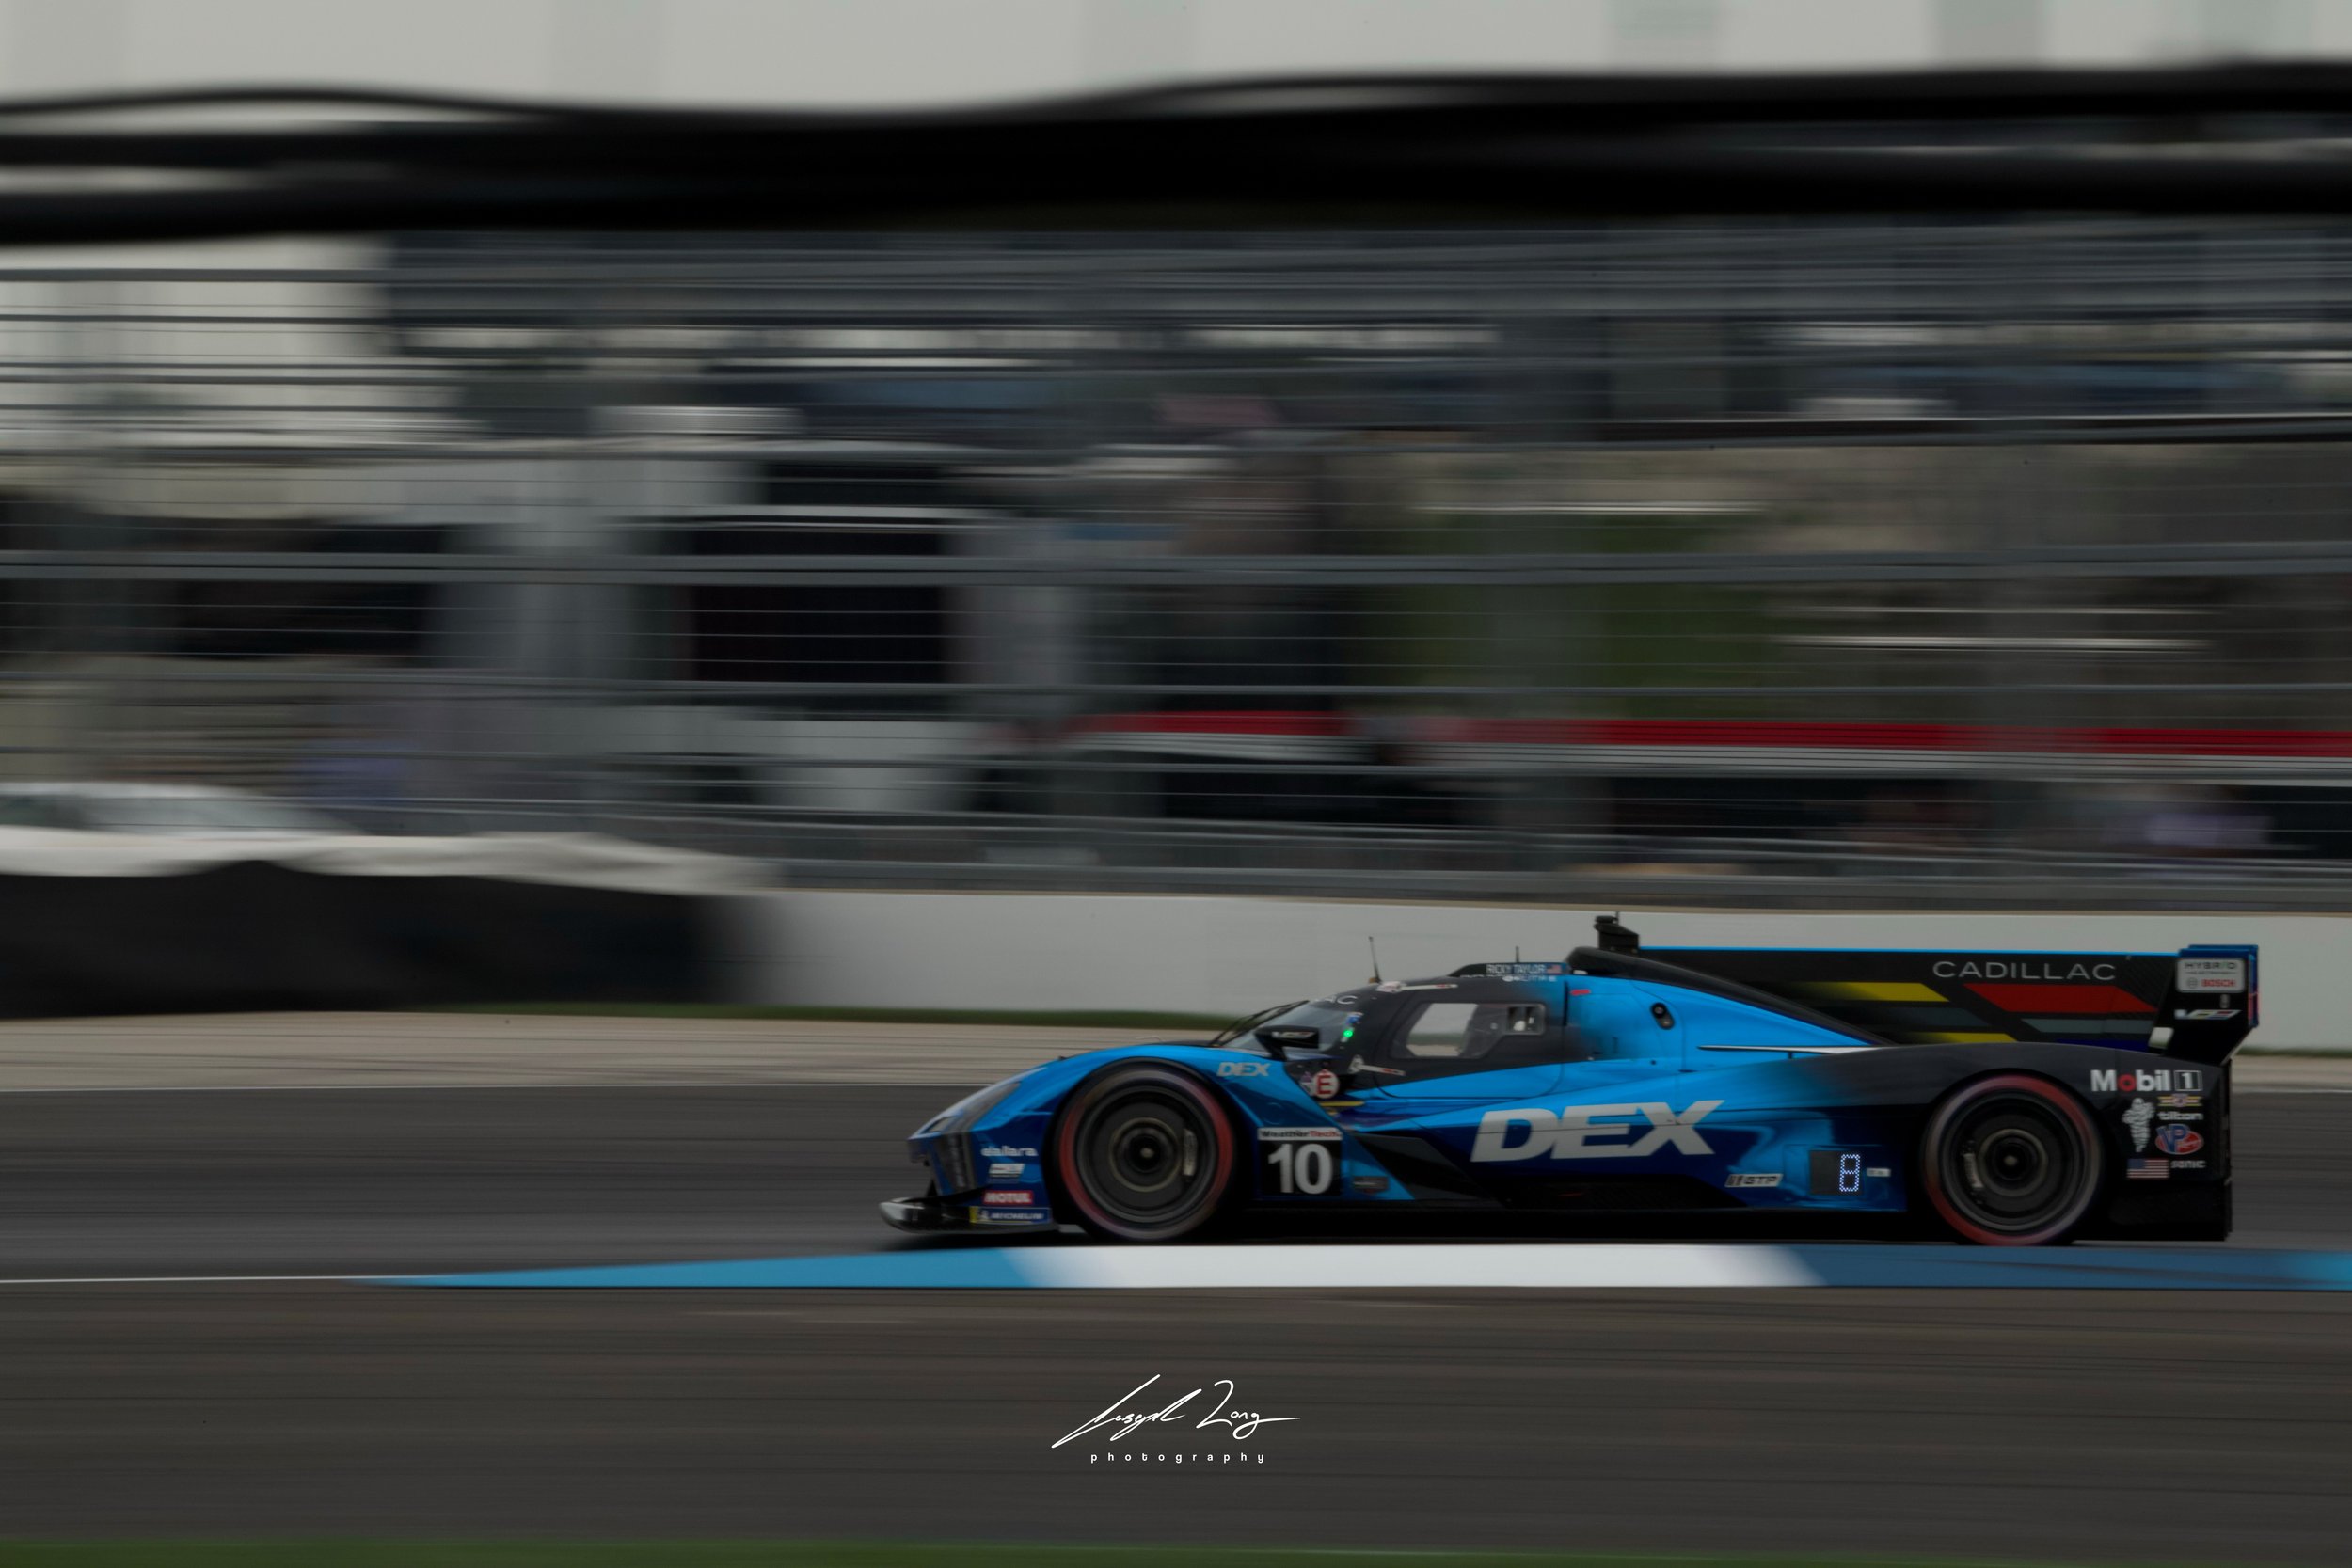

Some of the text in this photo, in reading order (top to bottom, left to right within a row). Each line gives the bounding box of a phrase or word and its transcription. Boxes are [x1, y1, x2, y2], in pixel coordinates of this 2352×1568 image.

[1513, 963, 1546, 974] TAYLOR
[1931, 960, 2116, 981] CADILLAC
[2201, 979, 2236, 988] BOSCH
[1216, 1062, 1271, 1077] DEX
[2090, 1069, 2171, 1092] Mobil
[1469, 1099, 1726, 1163] DEX
[1267, 1143, 1333, 1195] 10
[983, 1192, 1033, 1204] MOTUL
